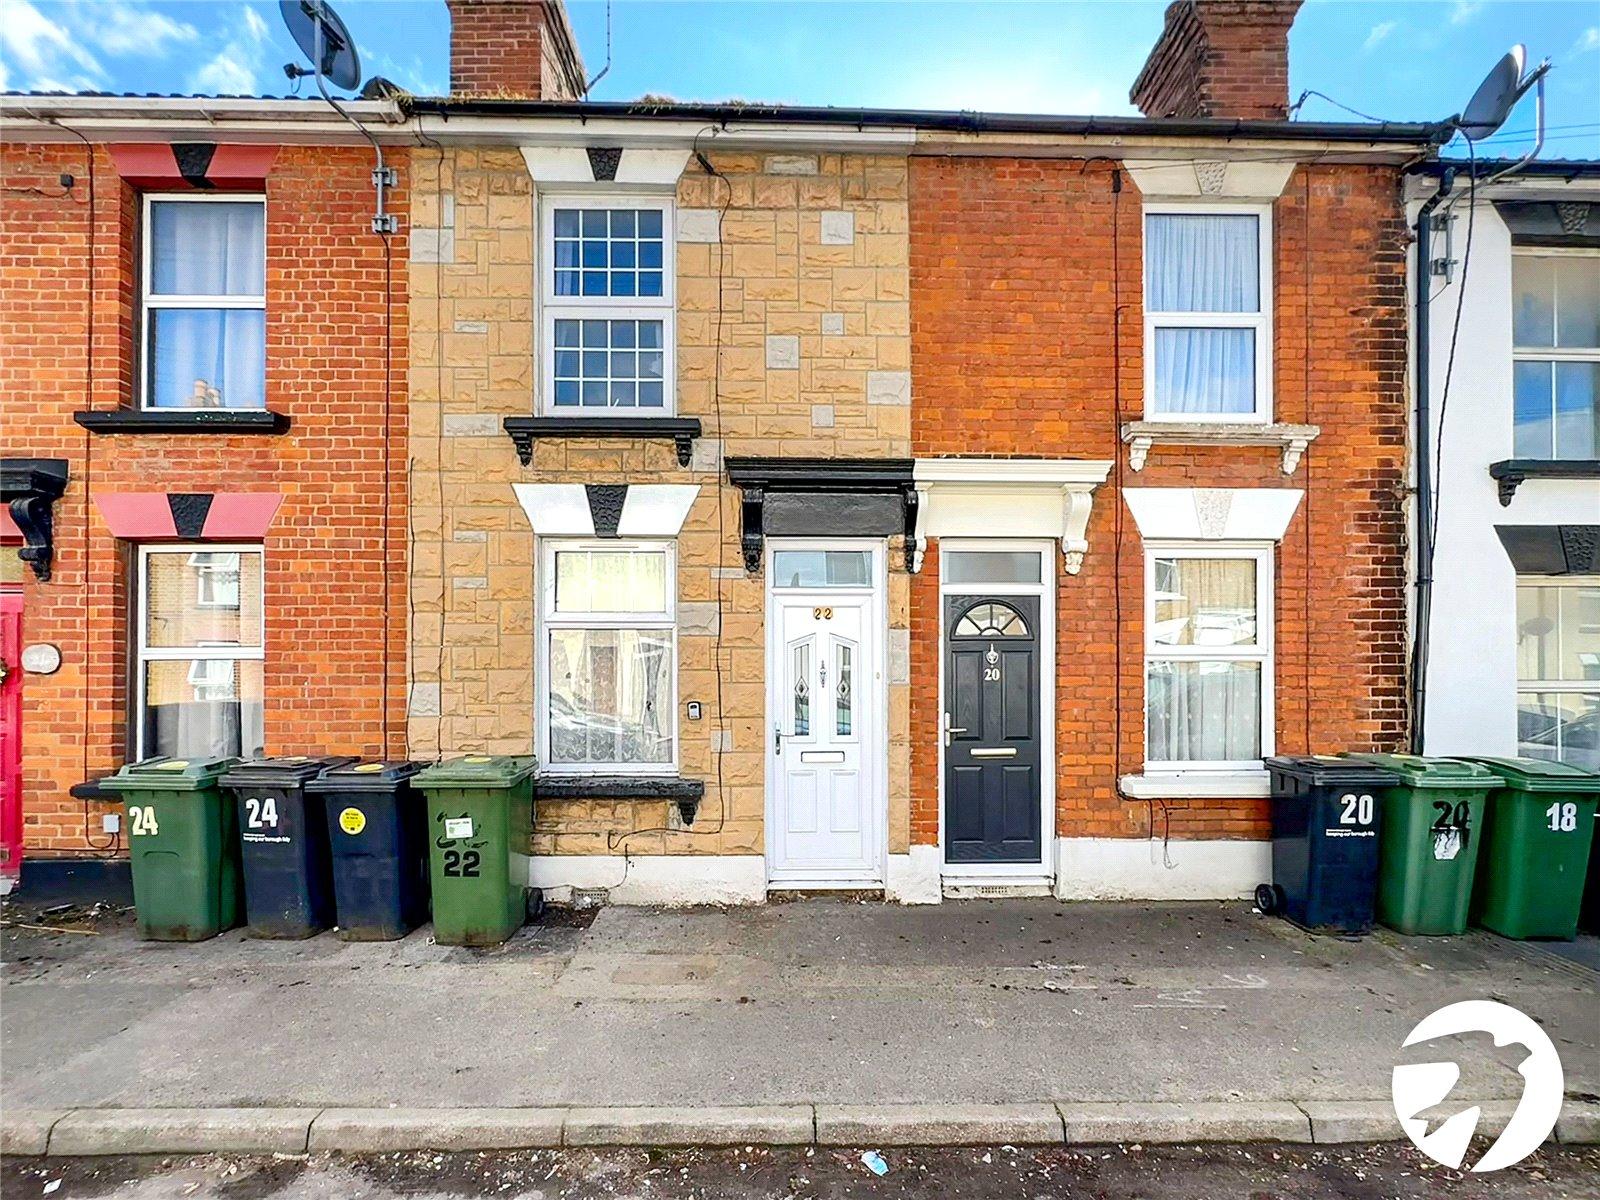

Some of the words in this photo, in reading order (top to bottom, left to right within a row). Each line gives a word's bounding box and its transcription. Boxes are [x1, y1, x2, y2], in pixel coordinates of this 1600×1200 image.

[815, 607, 832, 620] 22
[984, 668, 1000, 681] 20
[129, 805, 159, 836] 24
[245, 798, 278, 828] 24
[1340, 794, 1374, 825] 20
[1546, 802, 1577, 832] 18
[444, 850, 480, 877] 22
